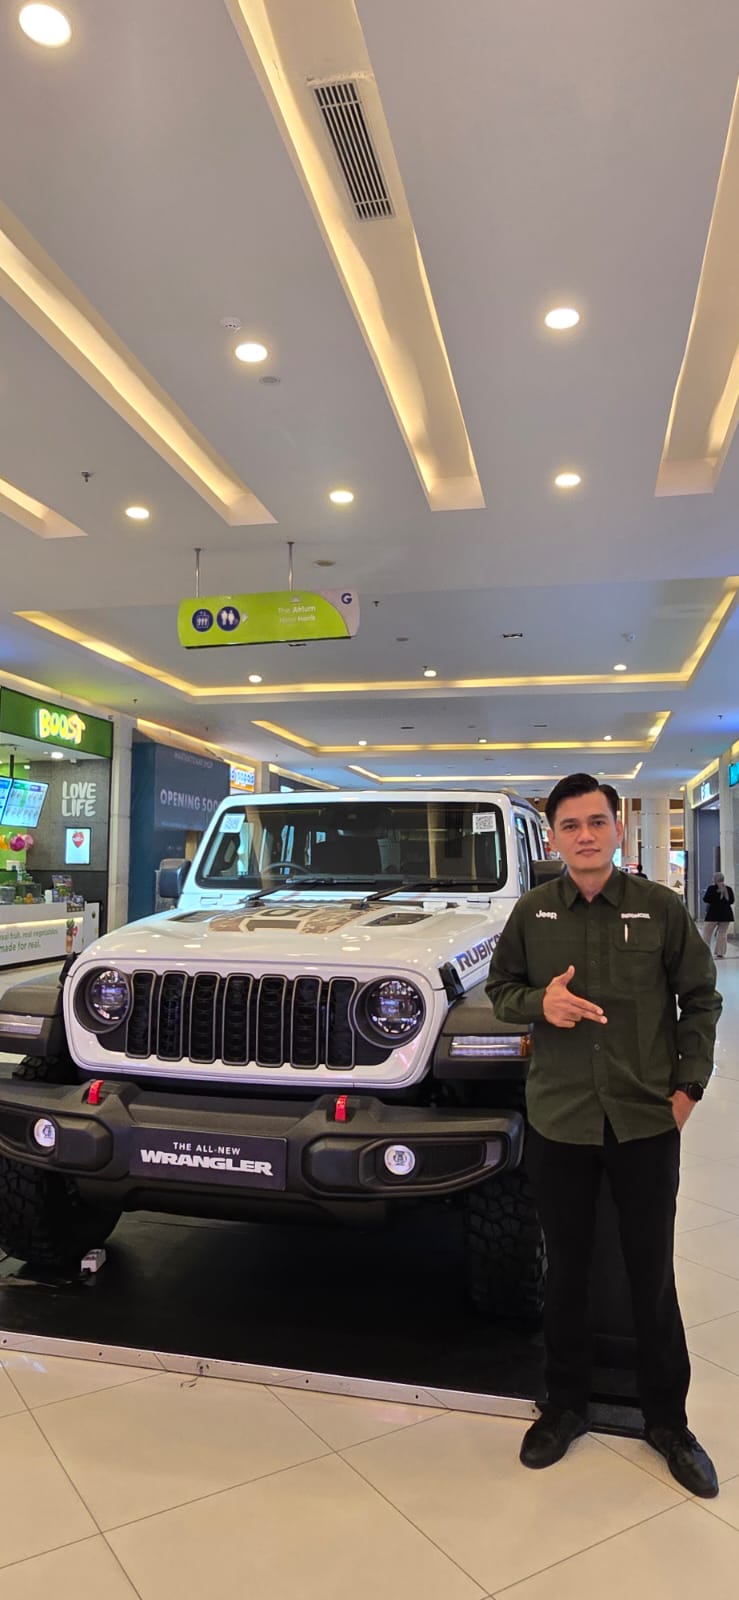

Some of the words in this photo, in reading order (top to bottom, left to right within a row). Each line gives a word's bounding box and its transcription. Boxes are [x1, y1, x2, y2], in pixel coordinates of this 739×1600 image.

[341, 593, 352, 604] G
[38, 708, 86, 745] BOOST
[62, 781, 97, 799] LOVE
[62, 799, 97, 817] LIFE
[160, 788, 201, 812] OPENING
[202, 797, 219, 812] SOO
[536, 909, 558, 920] Jeep
[18, 942, 27, 950] for
[173, 1141, 191, 1151] THE
[195, 1144, 241, 1156] ALL-NEW
[140, 1149, 274, 1176] WRANGLER
